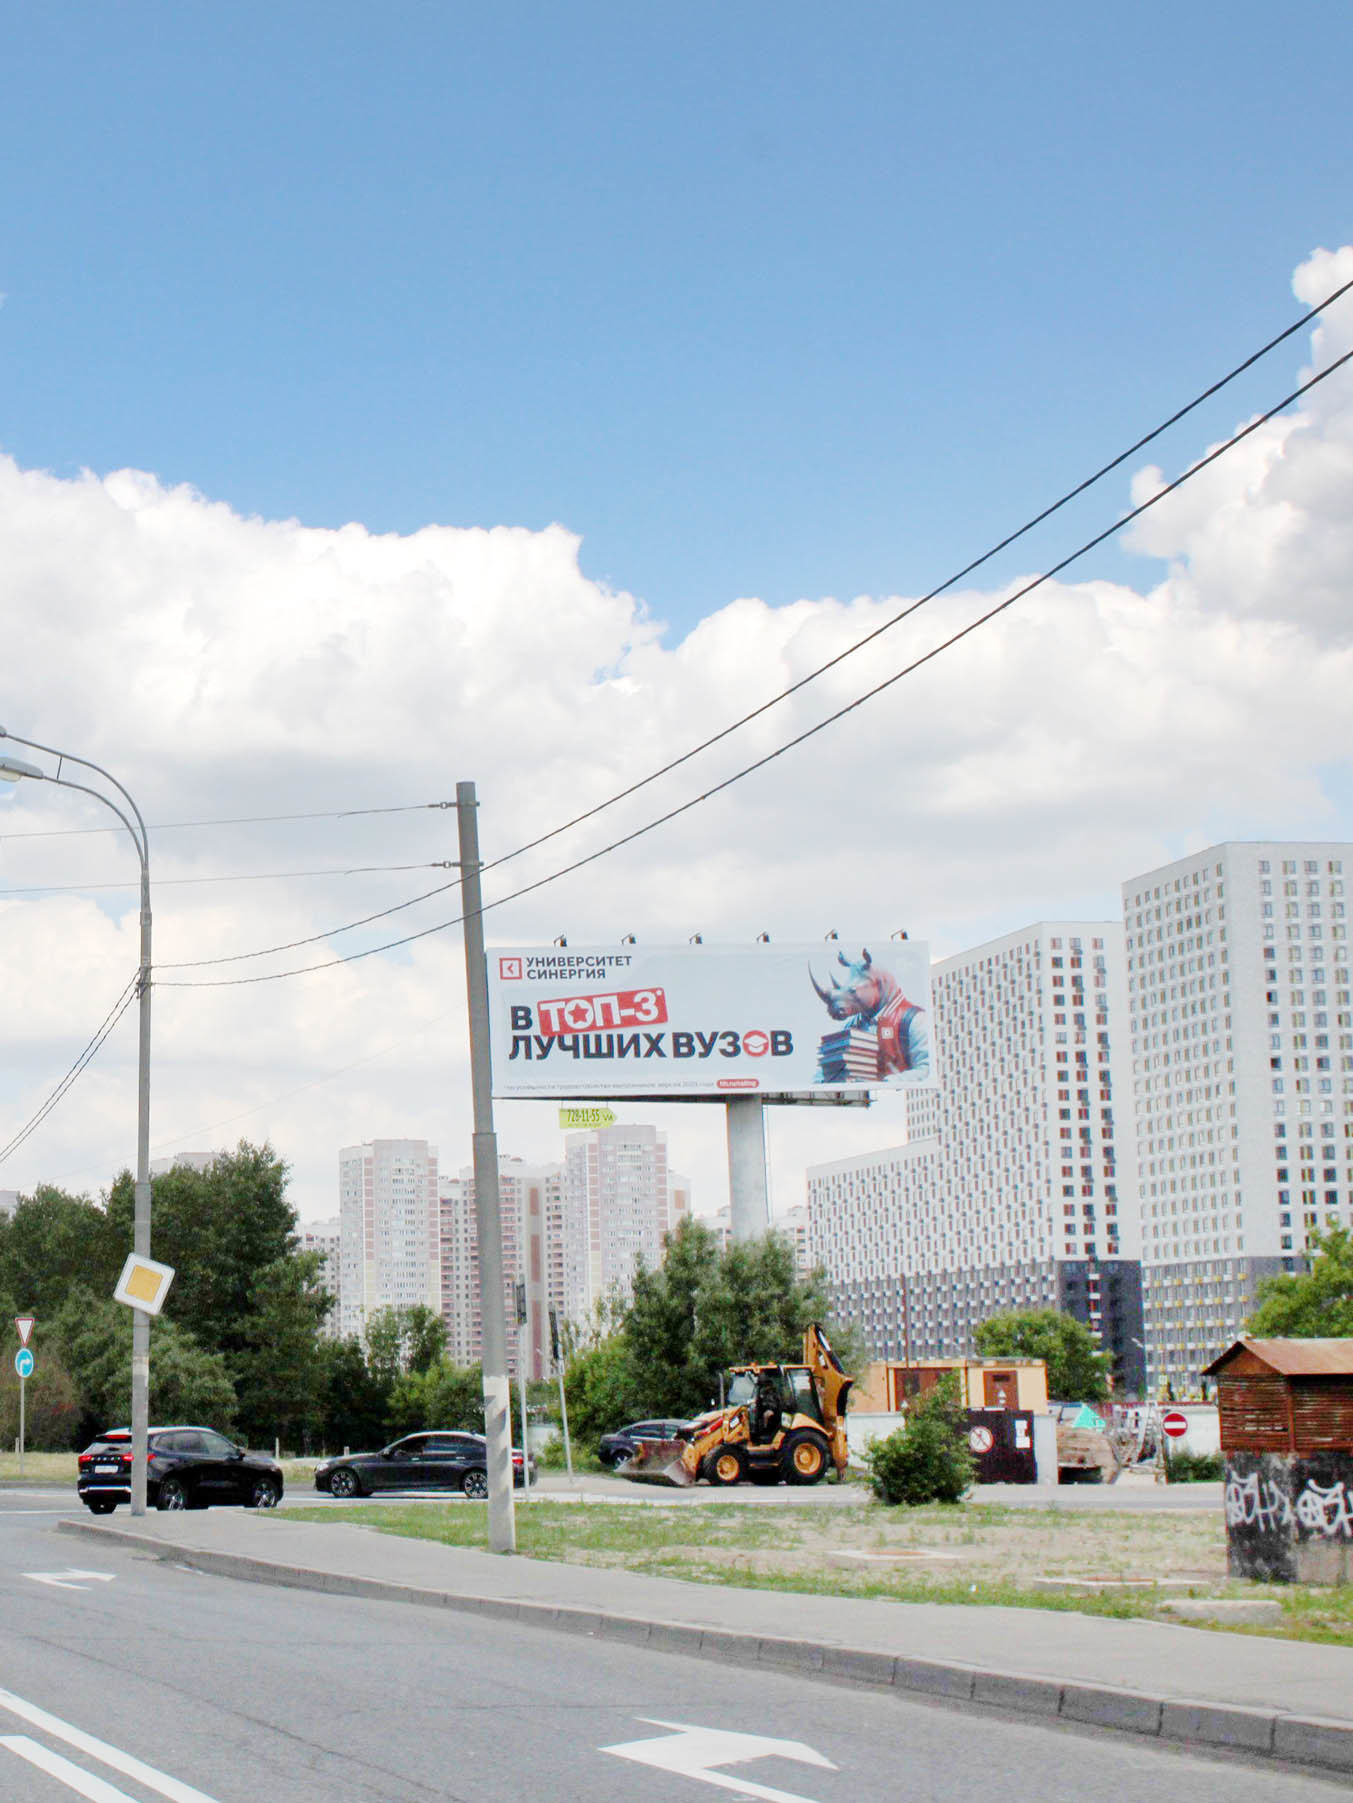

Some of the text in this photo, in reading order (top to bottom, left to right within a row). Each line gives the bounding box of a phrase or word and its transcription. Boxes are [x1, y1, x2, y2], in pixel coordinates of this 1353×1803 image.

[526, 955, 632, 968] УНИВЕРСИТЕТ
[526, 968, 606, 980] СИНЕРГИЯ
[510, 1005, 534, 1031] В
[509, 1029, 794, 1060] ЛУЧШИХ ВУЗОВ
